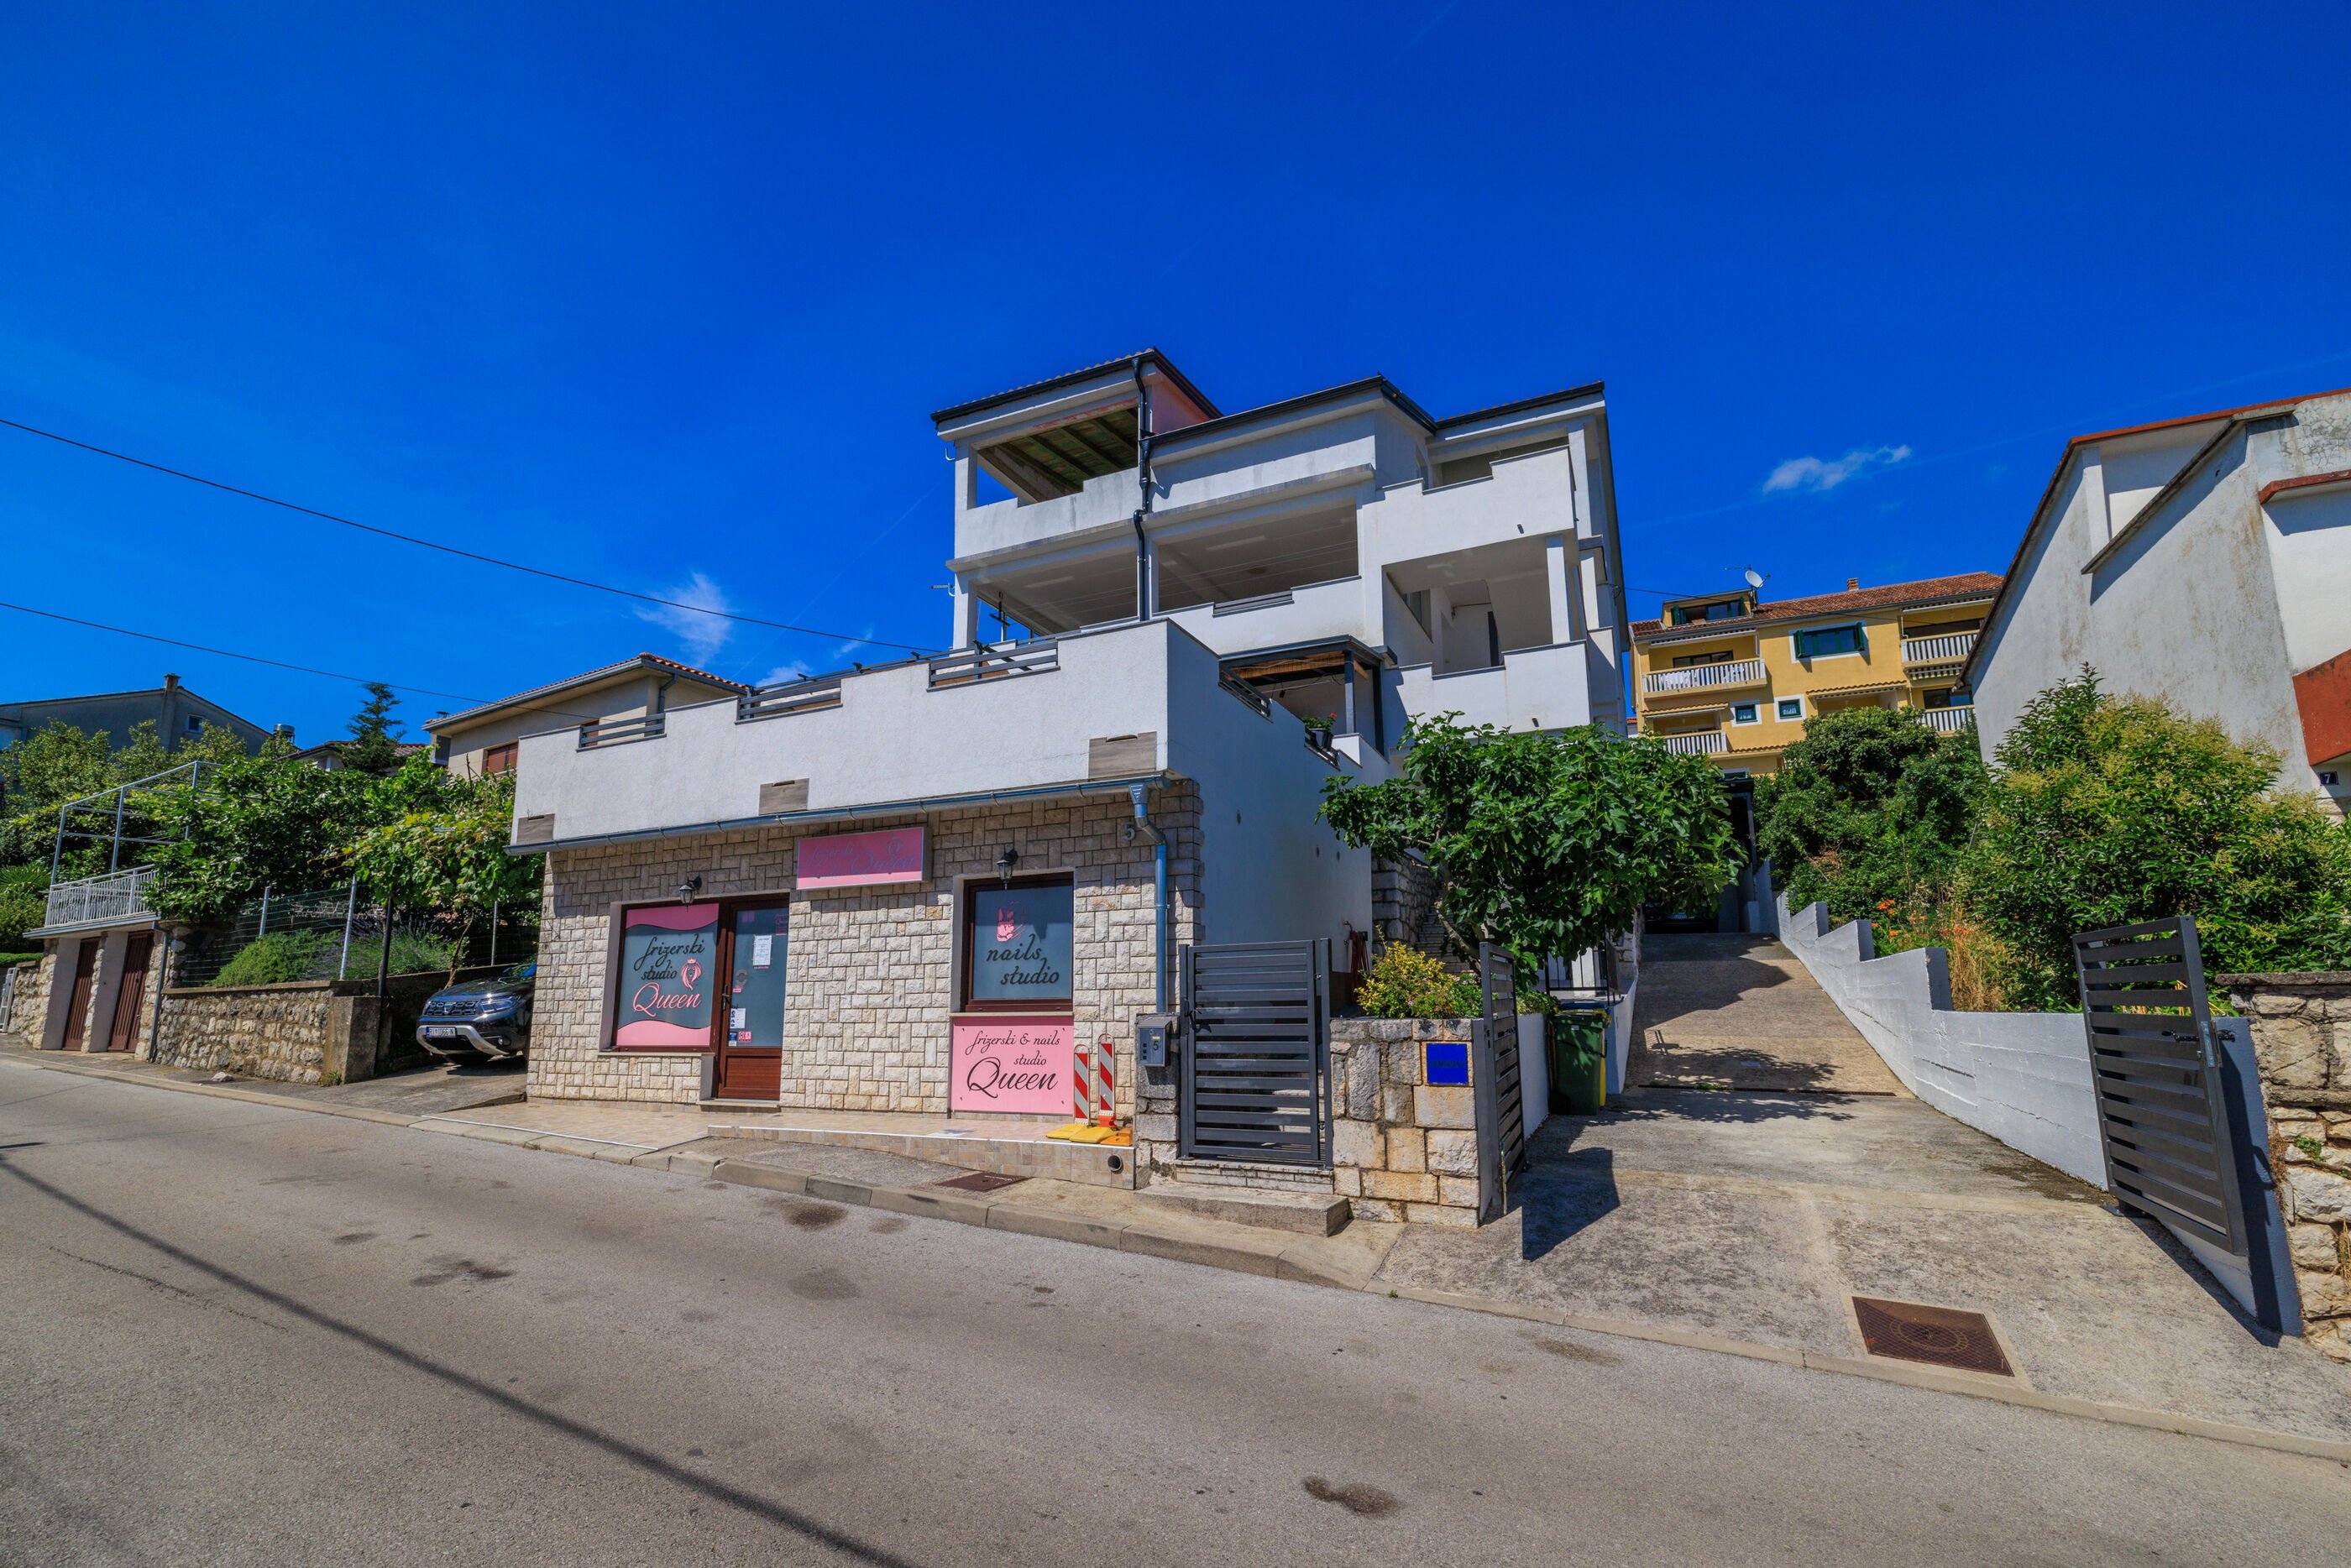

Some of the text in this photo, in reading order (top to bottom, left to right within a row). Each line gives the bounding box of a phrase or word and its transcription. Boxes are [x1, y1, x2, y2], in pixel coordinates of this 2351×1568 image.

[2324, 774, 2331, 783] 7
[633, 933, 705, 971] frizerski
[986, 933, 1042, 962] nails
[641, 959, 678, 980] studio
[1000, 957, 1060, 985] studio
[633, 981, 701, 1017] Queen
[965, 1030, 1060, 1055] frizerski & nails
[1153, 1040, 1159, 1051] 5
[1013, 1050, 1047, 1065] studio
[966, 1057, 1059, 1099] Queen
